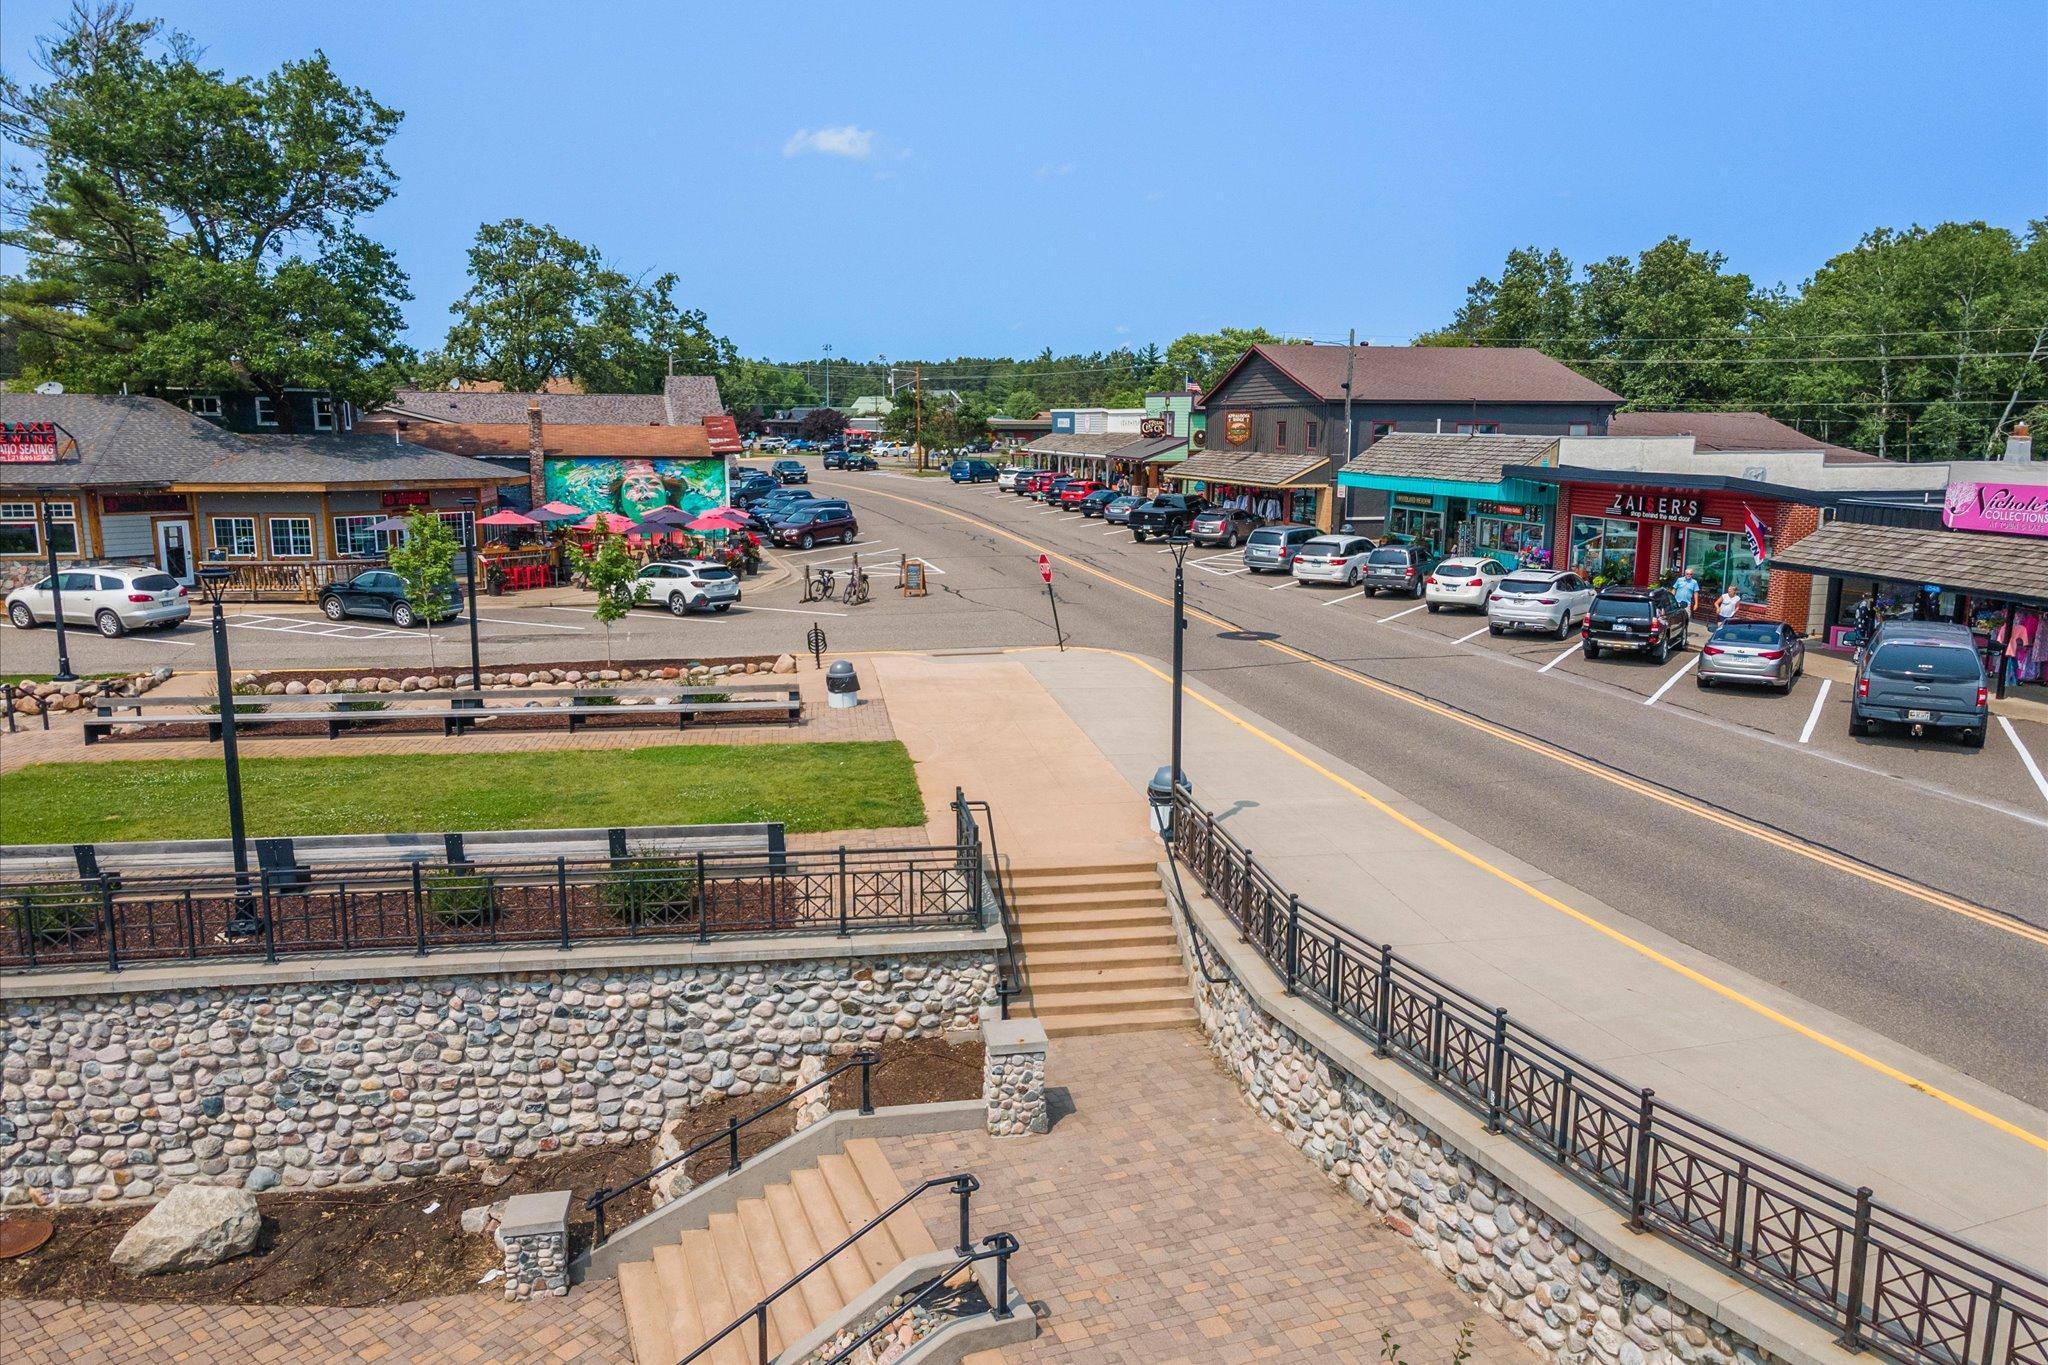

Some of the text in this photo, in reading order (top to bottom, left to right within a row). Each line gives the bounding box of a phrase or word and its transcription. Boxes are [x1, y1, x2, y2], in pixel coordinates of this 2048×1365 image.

[13, 421, 53, 432] AXE
[19, 443, 54, 455] SEATING
[1613, 494, 1698, 517] ZAISER'S
[1630, 511, 1641, 519] shop
[1985, 510, 2048, 524] COLLECTIONS
[1746, 530, 1760, 556] PEN
